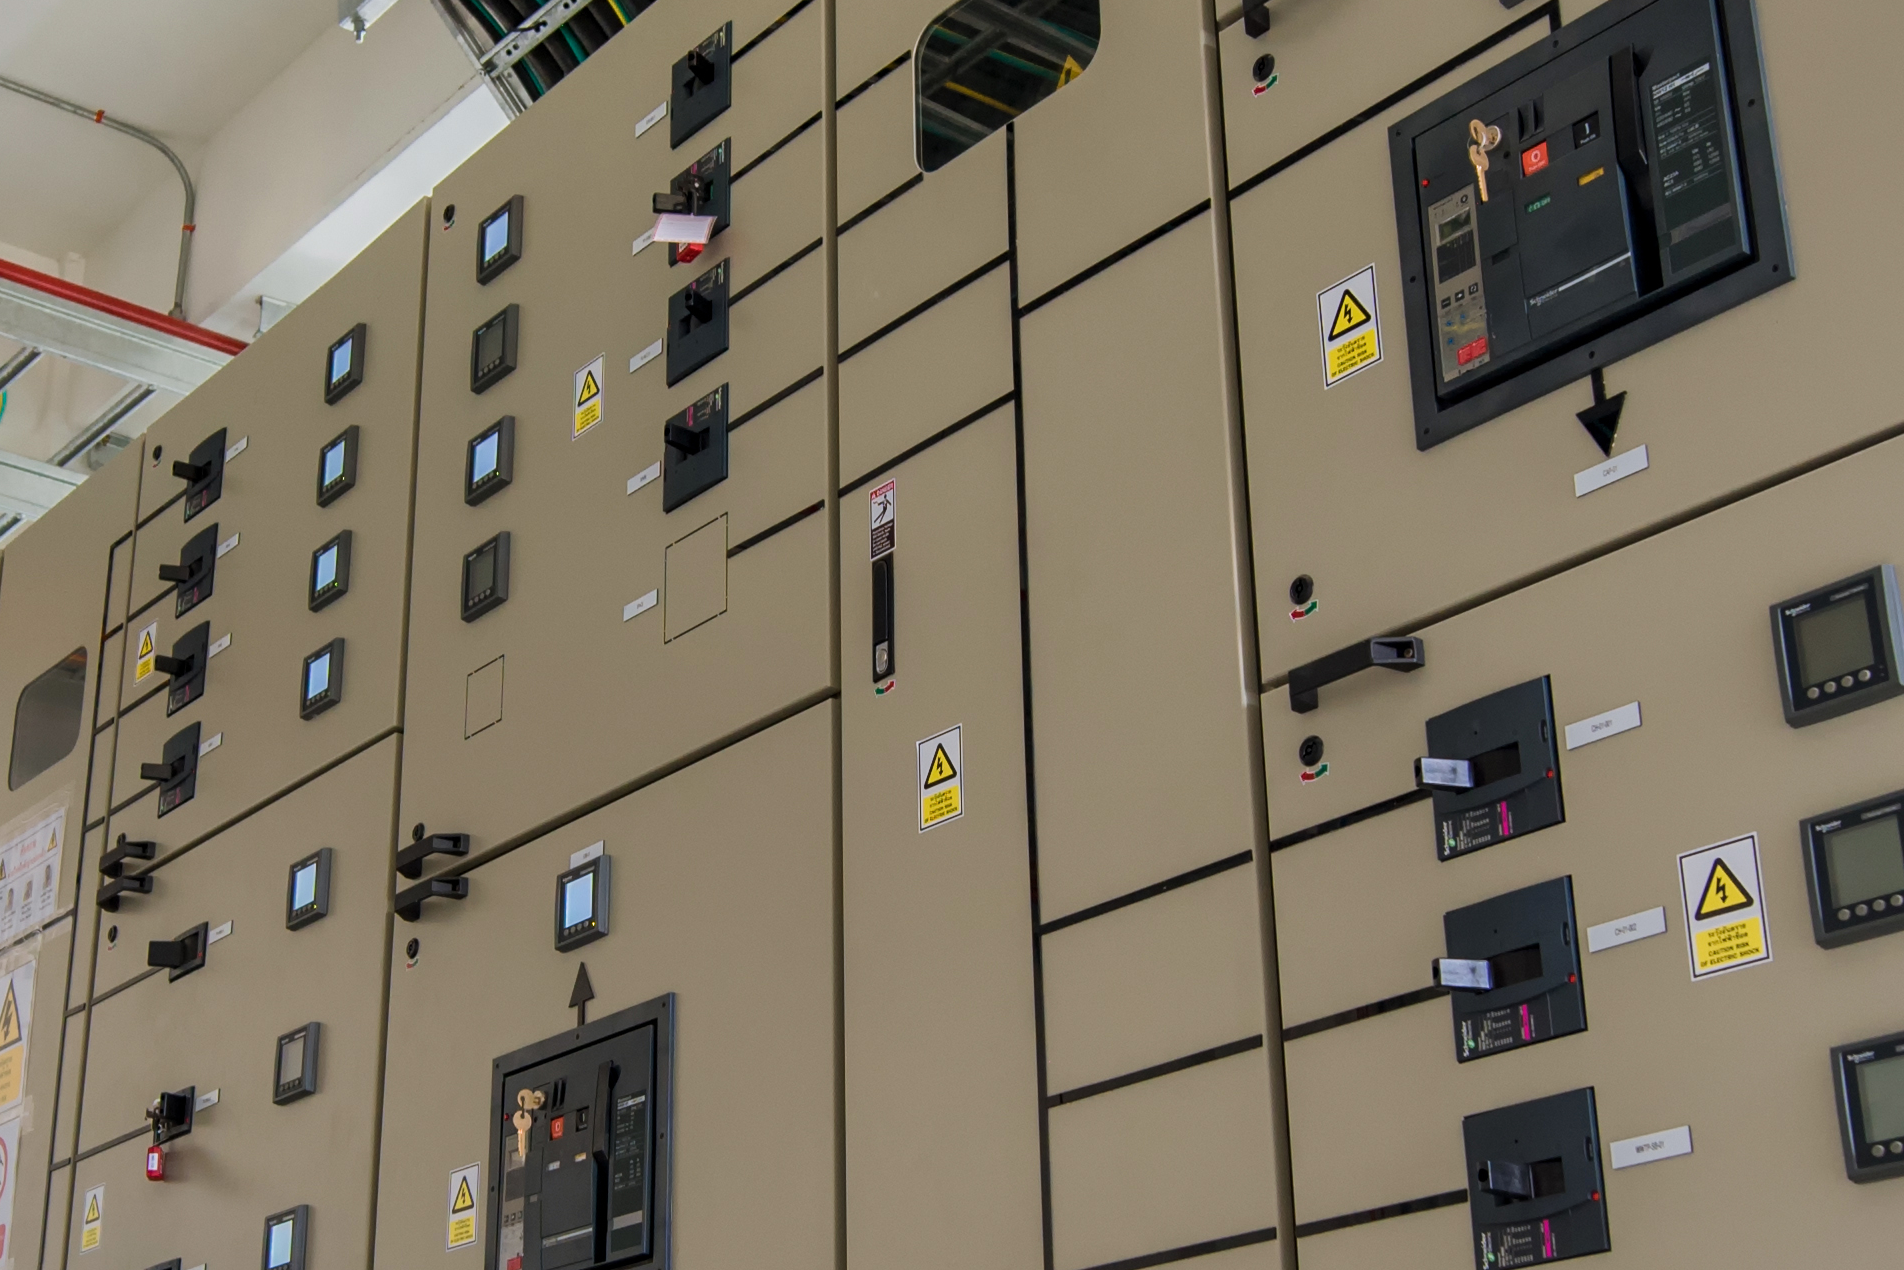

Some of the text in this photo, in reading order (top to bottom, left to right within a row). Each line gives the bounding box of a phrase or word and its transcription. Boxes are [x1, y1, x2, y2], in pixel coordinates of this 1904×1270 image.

[1707, 940, 1749, 958] CAUTION RISK
[1709, 952, 1738, 966] ELECTRIC
[1739, 946, 1760, 958] SHOCK
[1481, 1233, 1489, 1270] Schneider
